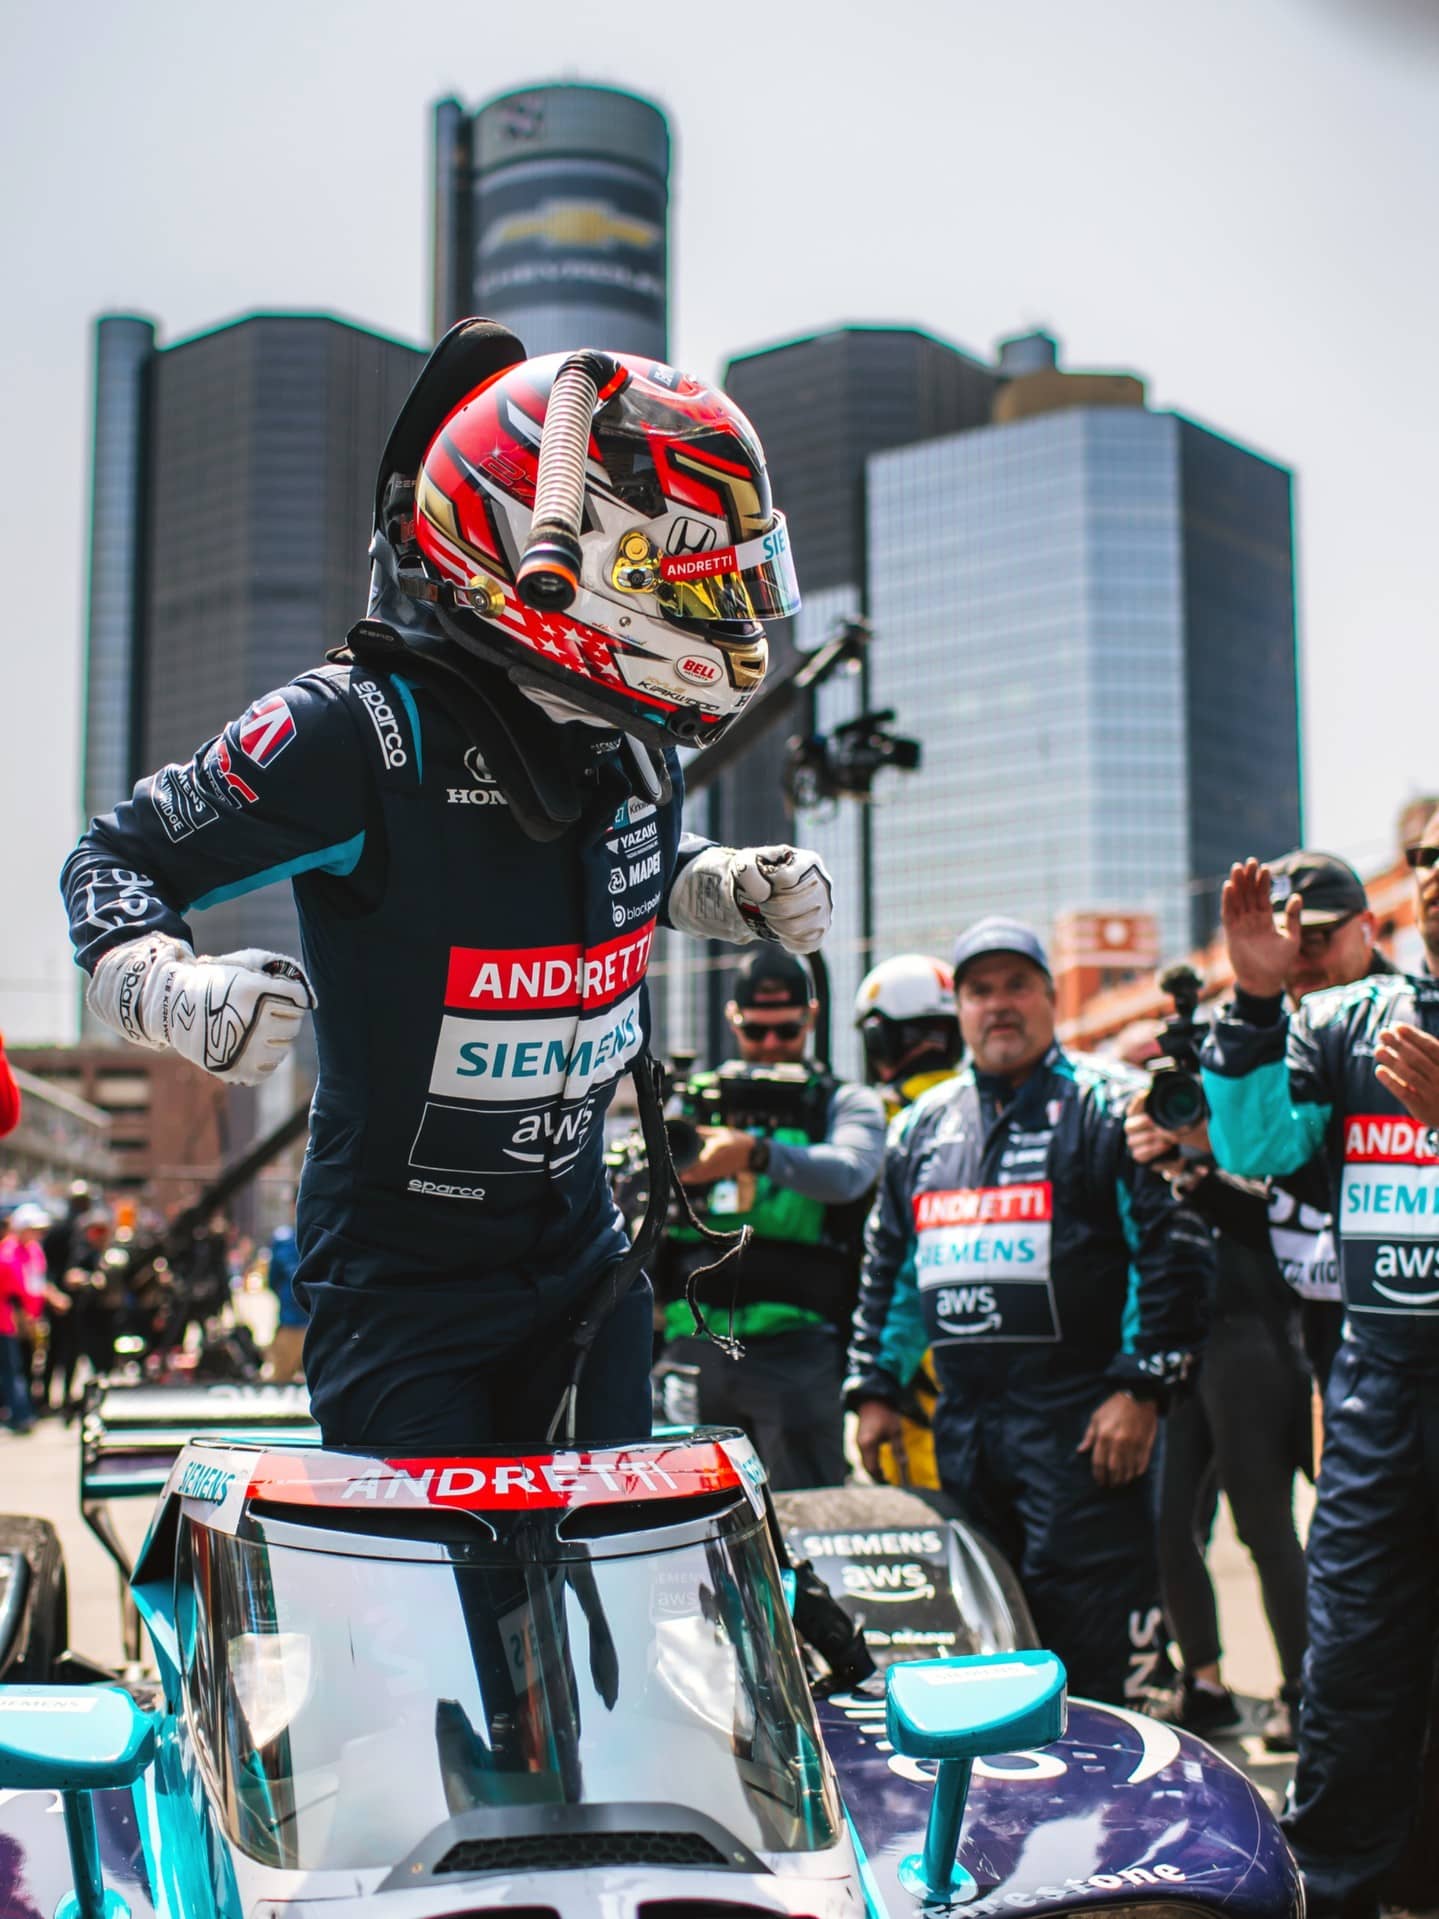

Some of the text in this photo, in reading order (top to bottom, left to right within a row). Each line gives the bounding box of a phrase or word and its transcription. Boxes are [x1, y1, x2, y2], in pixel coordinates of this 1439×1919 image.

[763, 531, 787, 560] SIE
[667, 555, 733, 576] ANDRETTI
[682, 659, 716, 680] BELL
[352, 681, 407, 770] sparco
[447, 788, 509, 805] HON
[620, 821, 658, 849] YAZAKI
[469, 932, 653, 999] ANDRETTI
[456, 1007, 637, 1078] SIEMENS
[511, 1098, 596, 1145] aws
[1346, 1122, 1437, 1158] ANDR
[407, 1178, 486, 1200] sparco
[919, 1186, 1045, 1223] ANDRETTI
[936, 1286, 997, 1316] aws
[178, 1461, 236, 1506] SIEMENS
[341, 1460, 678, 1500] ANDRETTI
[803, 1530, 943, 1558] SIEMENS
[841, 1563, 927, 1588] aws
